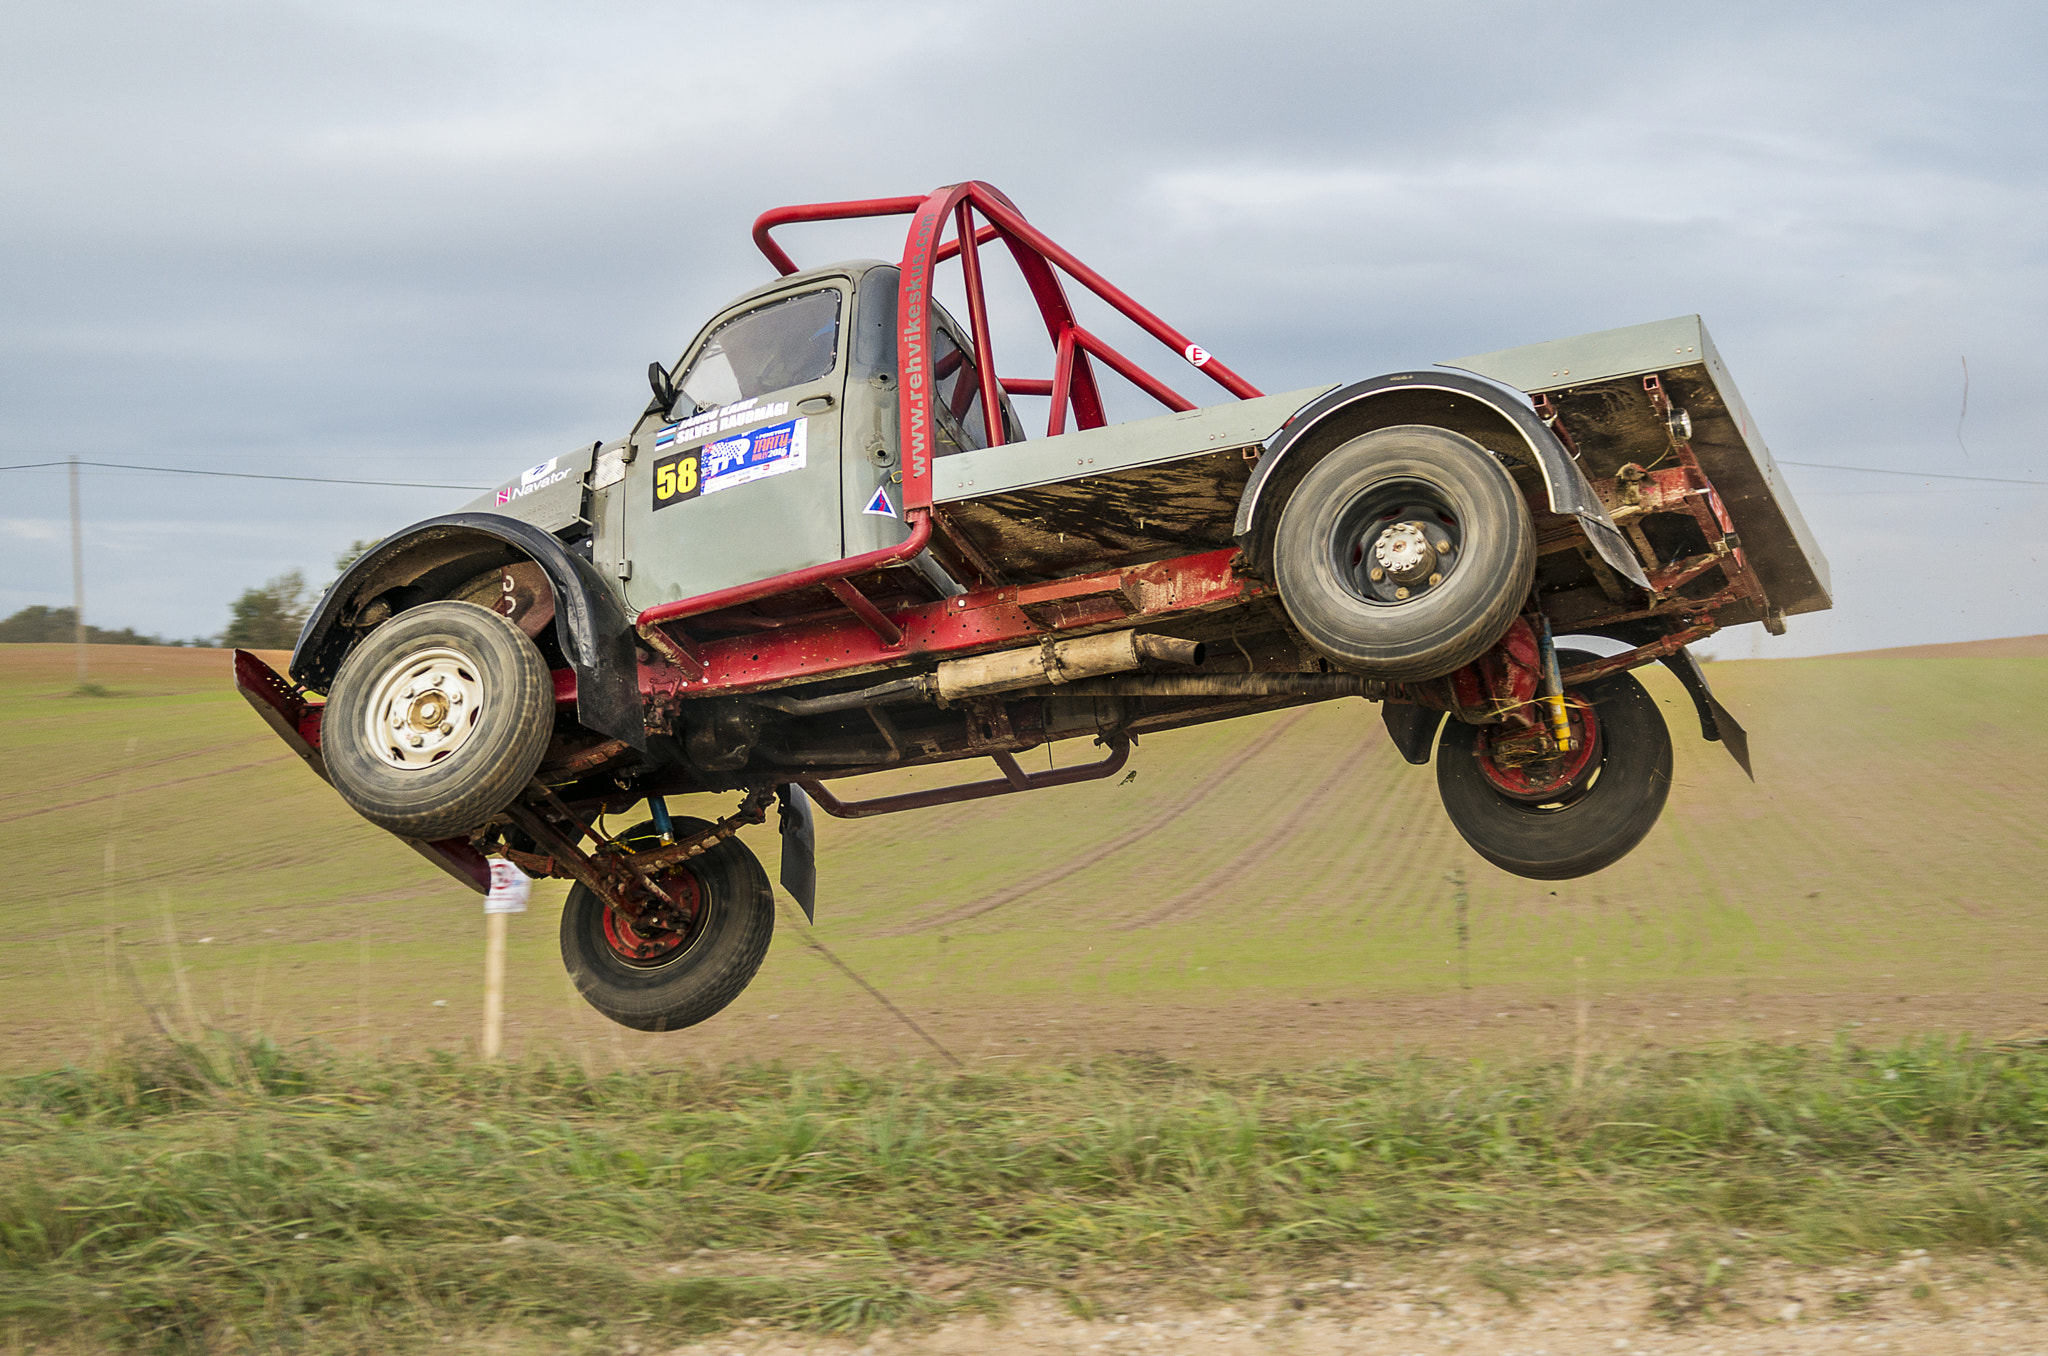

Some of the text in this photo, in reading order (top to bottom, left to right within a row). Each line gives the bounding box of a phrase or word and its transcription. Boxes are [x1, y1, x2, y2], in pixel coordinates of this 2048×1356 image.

[904, 213, 935, 478] www.rehvikeskus.com
[1192, 347, 1203, 361] E
[719, 397, 759, 417] KAMP
[675, 401, 789, 445] SILVER RAUDMÄGI
[752, 432, 790, 454] TARTU
[767, 446, 788, 458] 2016
[512, 467, 572, 500] Navator
[656, 456, 698, 501] 58
